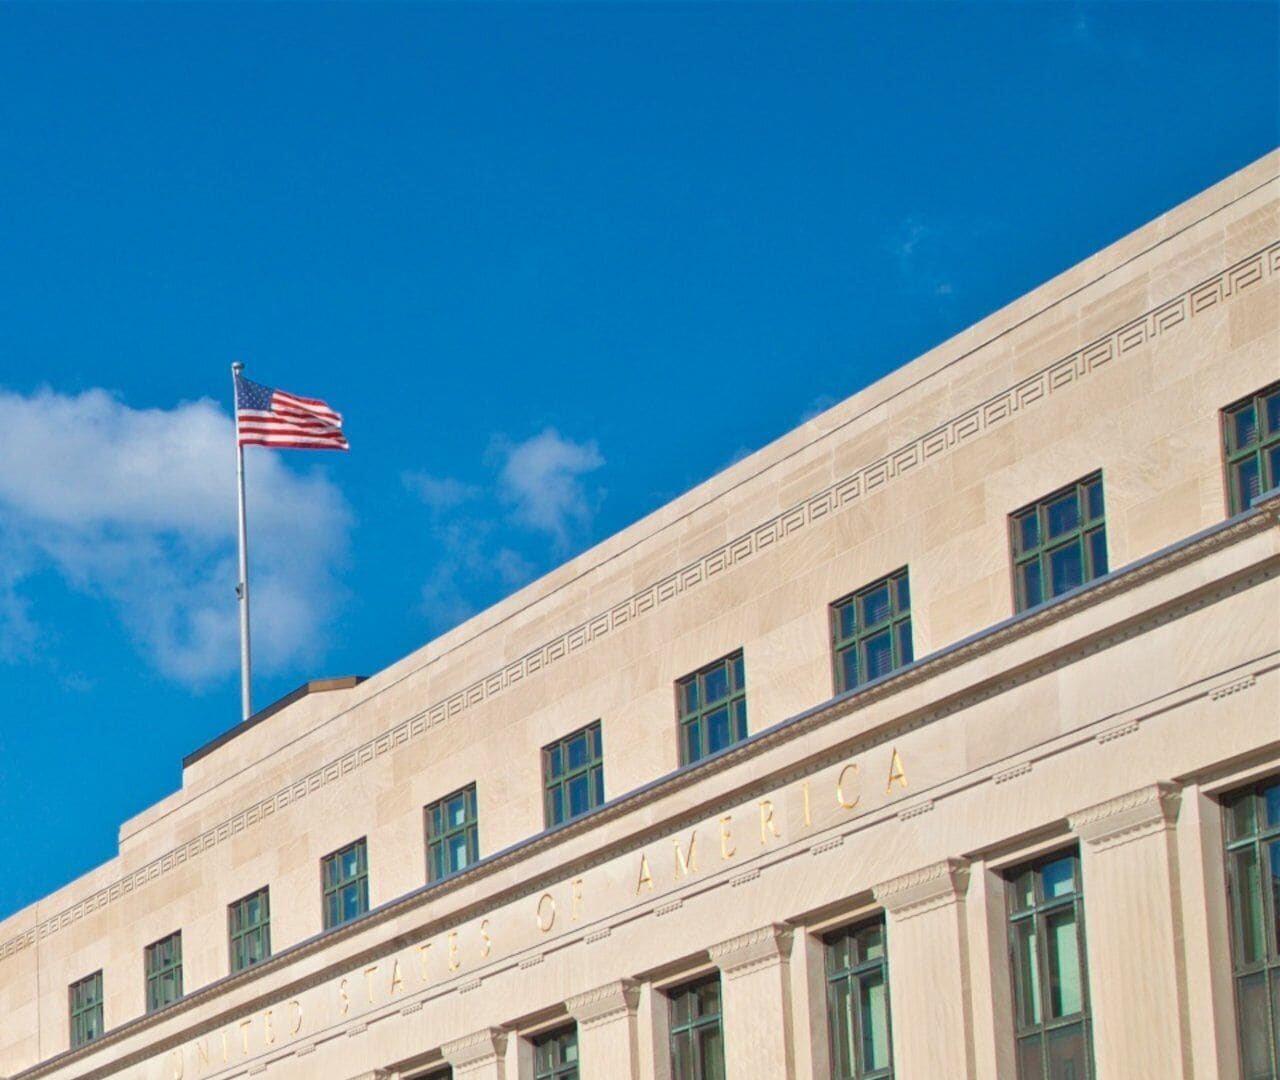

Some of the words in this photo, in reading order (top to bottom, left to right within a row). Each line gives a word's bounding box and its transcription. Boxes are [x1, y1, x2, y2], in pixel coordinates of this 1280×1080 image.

[339, 919, 492, 1016] STATES
[536, 878, 584, 933] OF
[636, 747, 909, 897] AMERICA
